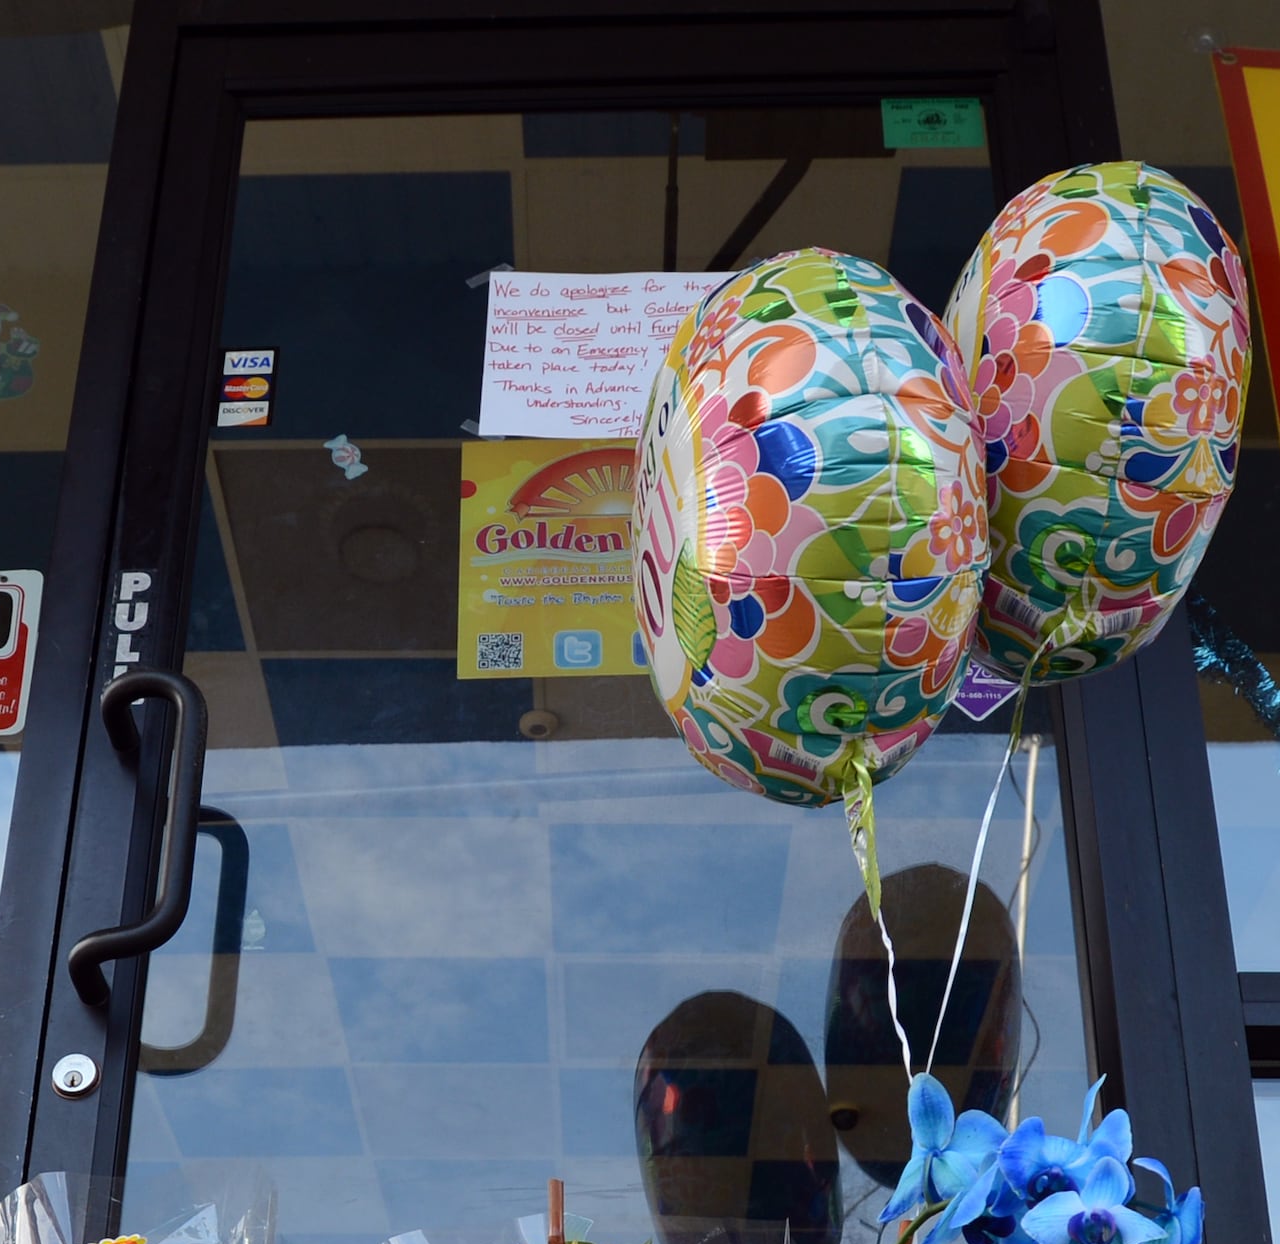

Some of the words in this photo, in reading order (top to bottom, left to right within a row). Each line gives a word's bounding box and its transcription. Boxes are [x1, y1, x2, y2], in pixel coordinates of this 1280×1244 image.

[494, 279, 520, 298] We
[529, 282, 551, 297] do
[560, 283, 632, 301] apologize
[641, 278, 667, 293] for
[494, 306, 587, 317] inconvenience
[607, 302, 631, 315] but
[491, 321, 518, 336] will
[526, 321, 546, 335] be
[554, 322, 600, 336] closed
[610, 320, 642, 335] until
[489, 341, 520, 353] Due
[523, 342, 542, 354] to
[551, 346, 570, 355] an
[577, 344, 649, 359] Emergency
[229, 356, 270, 369] VISA
[489, 359, 532, 371] taken
[542, 363, 580, 376] place
[493, 380, 552, 394] Thanks
[565, 383, 578, 394] in
[585, 383, 642, 394] Advance
[222, 406, 265, 415] DISCOVER
[476, 521, 625, 555] Golden
